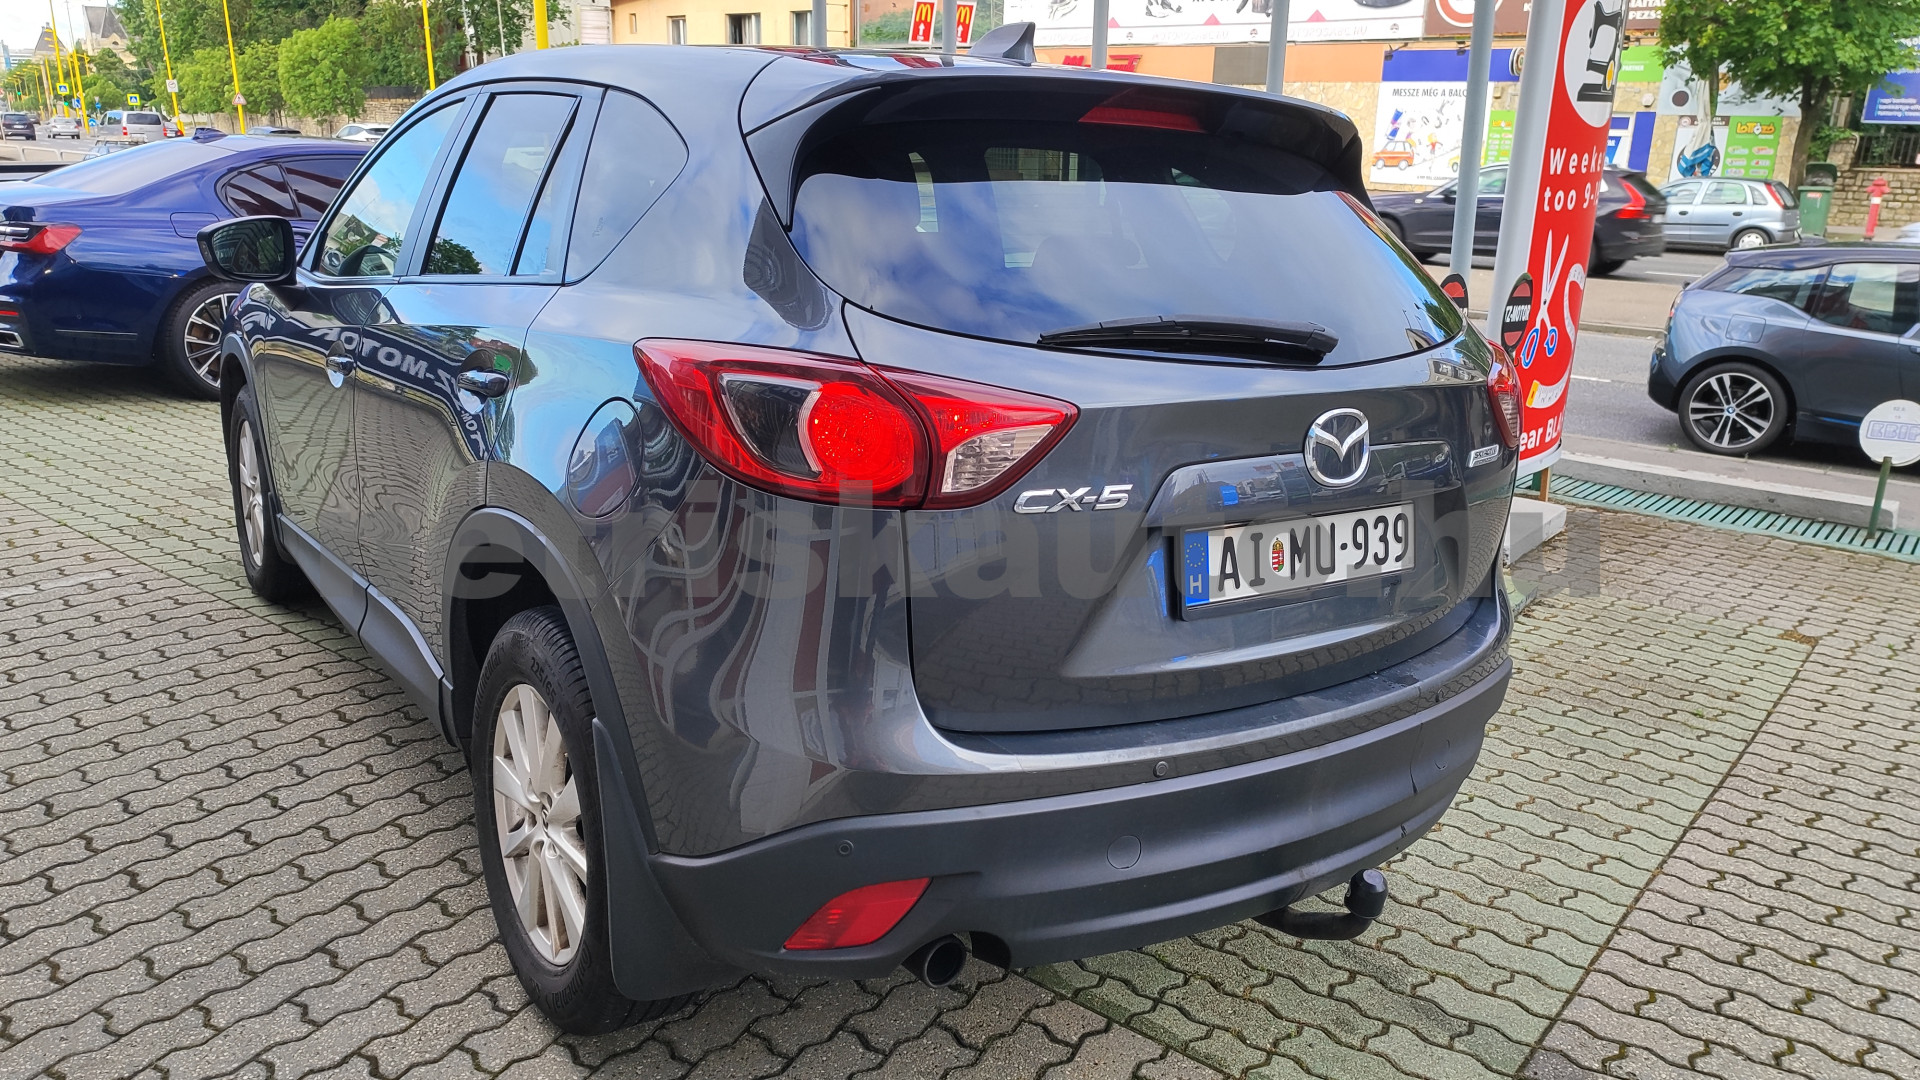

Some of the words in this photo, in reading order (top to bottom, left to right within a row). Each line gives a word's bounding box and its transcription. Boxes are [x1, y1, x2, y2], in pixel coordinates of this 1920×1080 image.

[1392, 88, 1420, 97] MESSZE
[1421, 87, 1439, 97] MÉG
[1440, 88, 1446, 97] A
[1549, 145, 1603, 175] Weeke
[1544, 186, 1577, 212] too
[1013, 484, 1133, 514] CX-5
[1189, 574, 1203, 595] H
